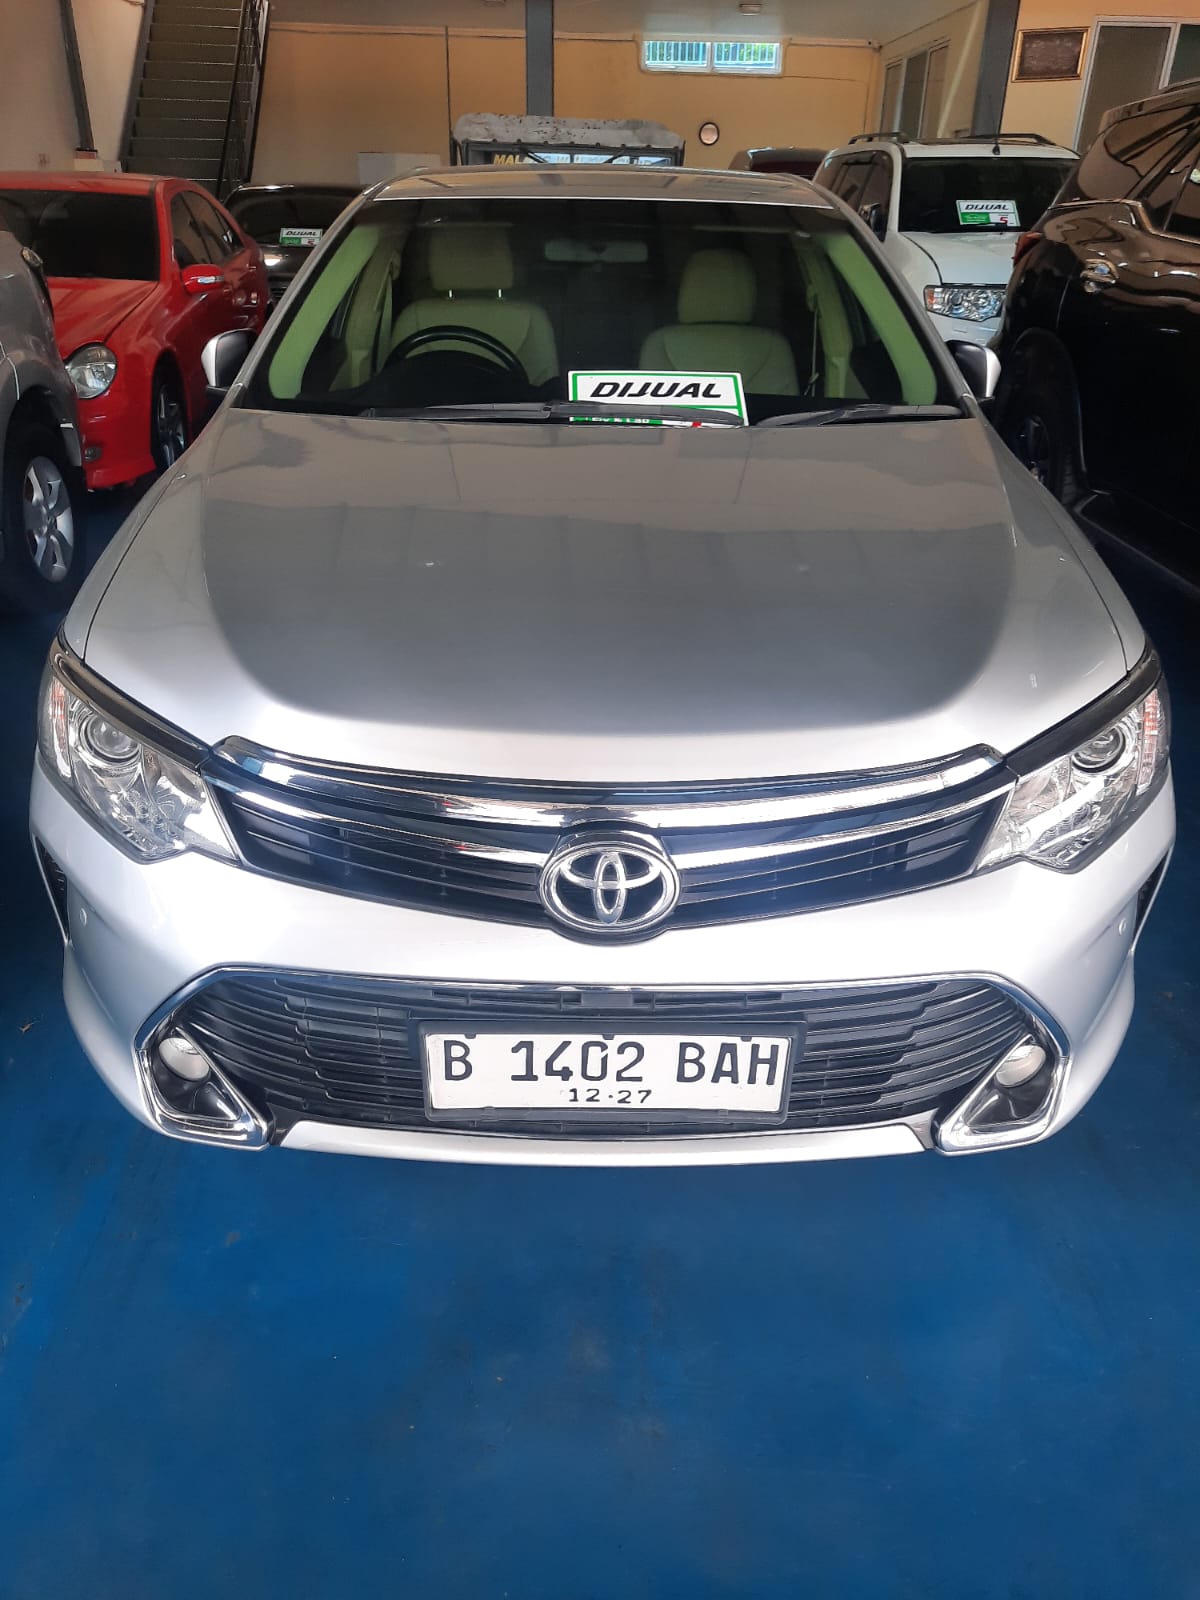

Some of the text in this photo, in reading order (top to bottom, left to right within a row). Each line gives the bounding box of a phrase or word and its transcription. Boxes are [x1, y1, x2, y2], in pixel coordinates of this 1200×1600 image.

[965, 203, 1009, 211] DIJUAL
[590, 382, 722, 398] DIJUAL
[443, 1040, 780, 1085] B 1402 BAH
